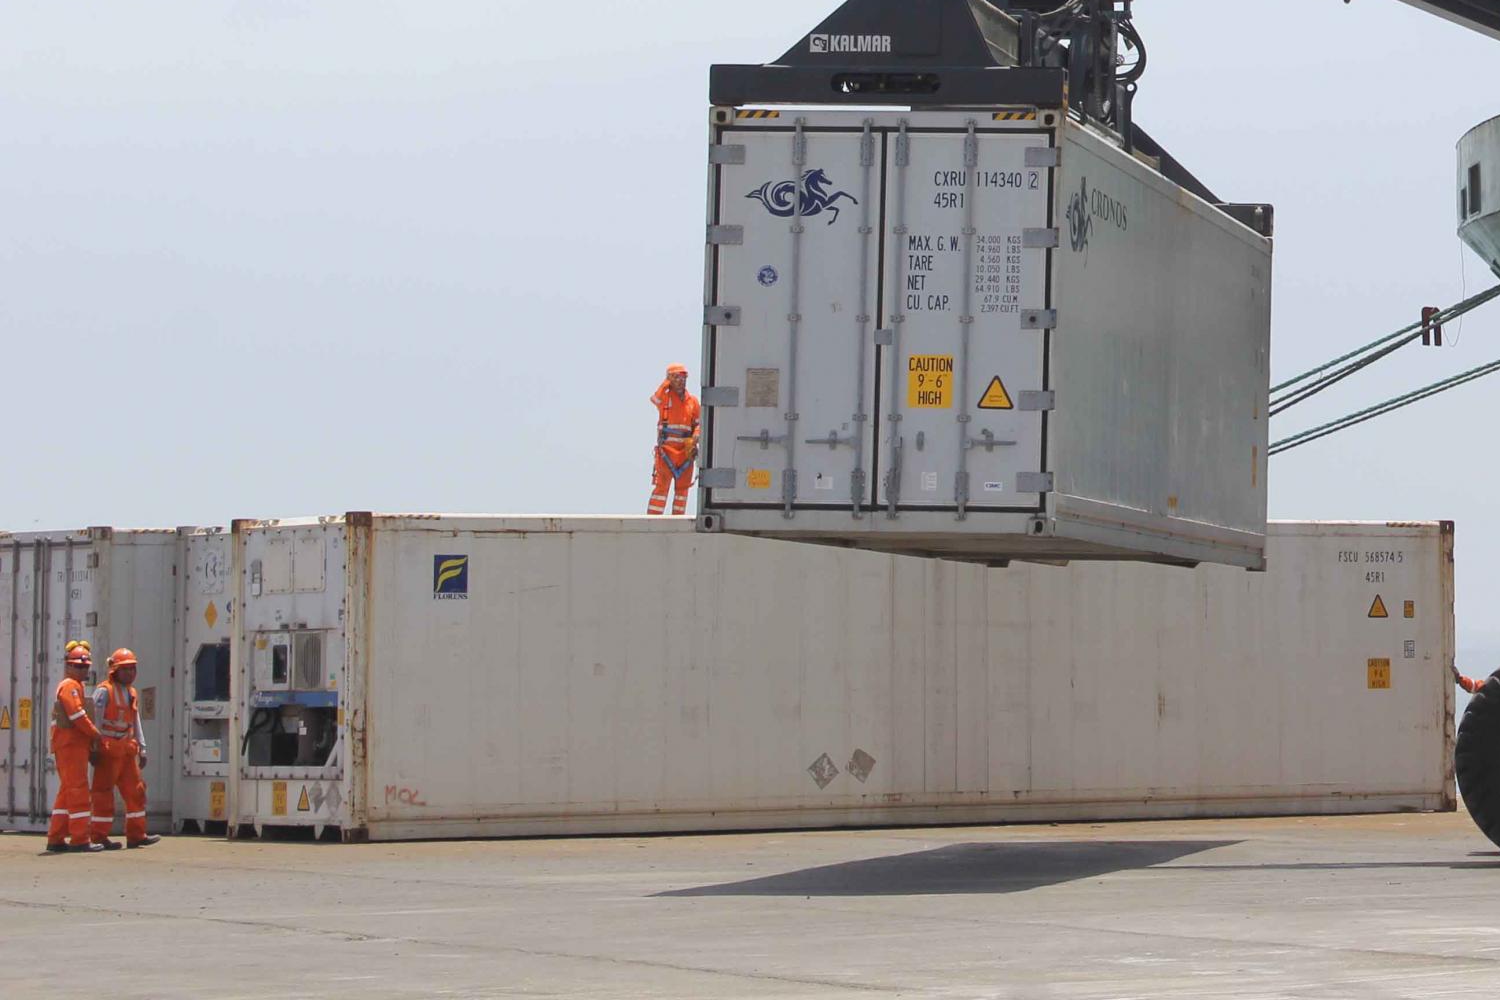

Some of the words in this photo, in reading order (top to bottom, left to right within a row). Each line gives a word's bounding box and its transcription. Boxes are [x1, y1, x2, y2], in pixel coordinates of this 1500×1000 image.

[830, 35, 891, 52] KALMAR
[934, 171, 966, 187] CXRU
[977, 171, 1022, 188] 114340
[1028, 172, 1039, 189] 2
[934, 193, 964, 208] 45R1
[1091, 188, 1127, 231] CRONOS
[908, 236, 933, 251] MAX.
[1007, 236, 1021, 244] KGS
[1007, 245, 1021, 254] LBS
[908, 256, 933, 271] TARE
[1006, 255, 1021, 264] KGS
[1006, 265, 1020, 273] LBS
[907, 275, 925, 290] NET
[1006, 275, 1020, 283] KGS
[1006, 285, 1020, 293] LBS
[907, 295, 922, 310] CU.
[927, 295, 951, 311] CAP.
[909, 358, 953, 371] CAUTION
[917, 391, 942, 405] HIGH
[1338, 552, 1358, 562] FSCU
[1365, 572, 1385, 582] 45R1
